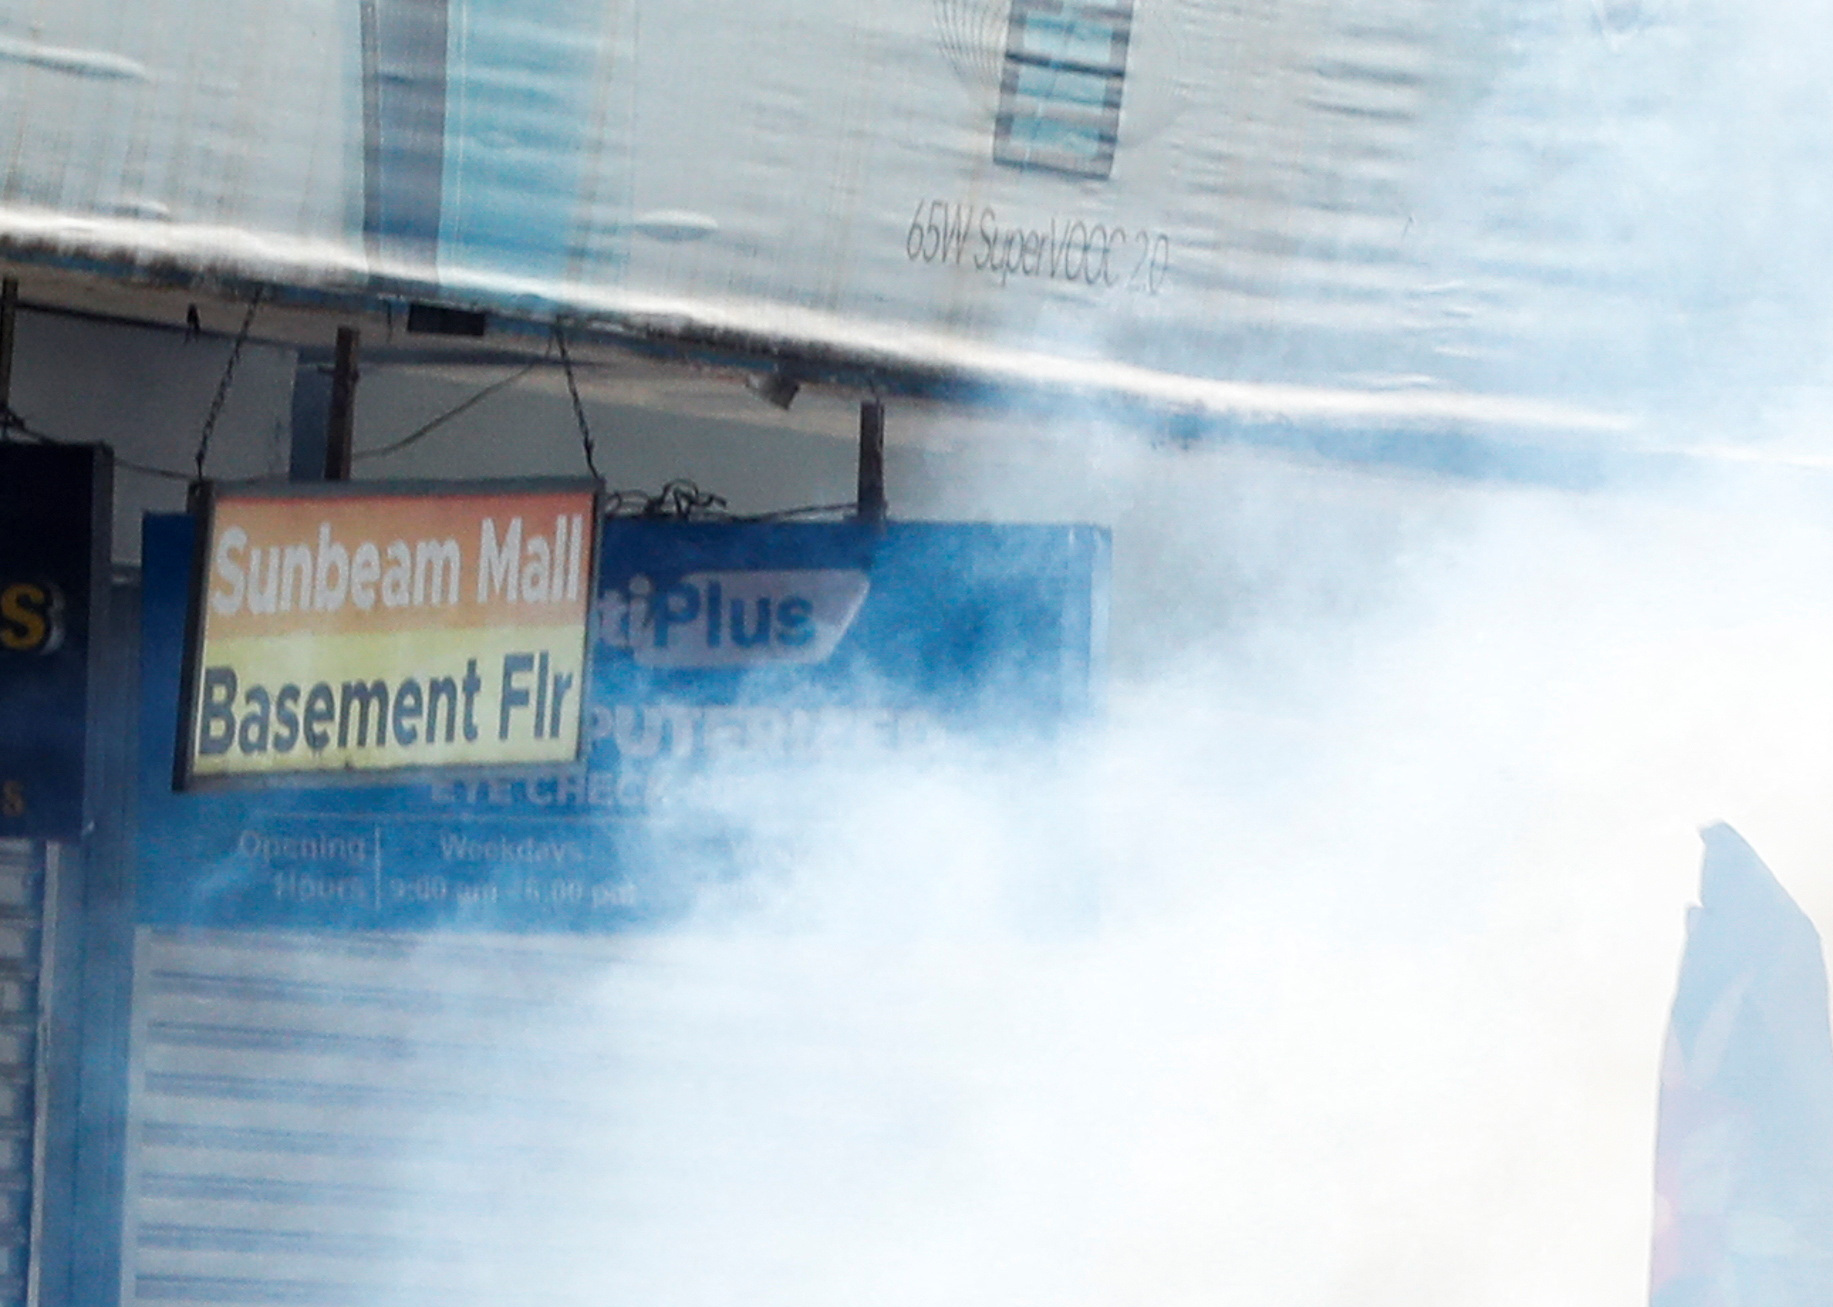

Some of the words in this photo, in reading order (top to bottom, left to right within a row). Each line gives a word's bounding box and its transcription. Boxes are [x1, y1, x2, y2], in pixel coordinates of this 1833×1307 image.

[906, 199, 972, 265] 65W
[211, 522, 461, 616] Sunbeam
[477, 513, 583, 602] Mall
[200, 658, 482, 755] Basement
[500, 650, 573, 741] Flr
[238, 828, 366, 864] Opening
[440, 832, 582, 866] Weekdays
[274, 872, 367, 902] Hours
